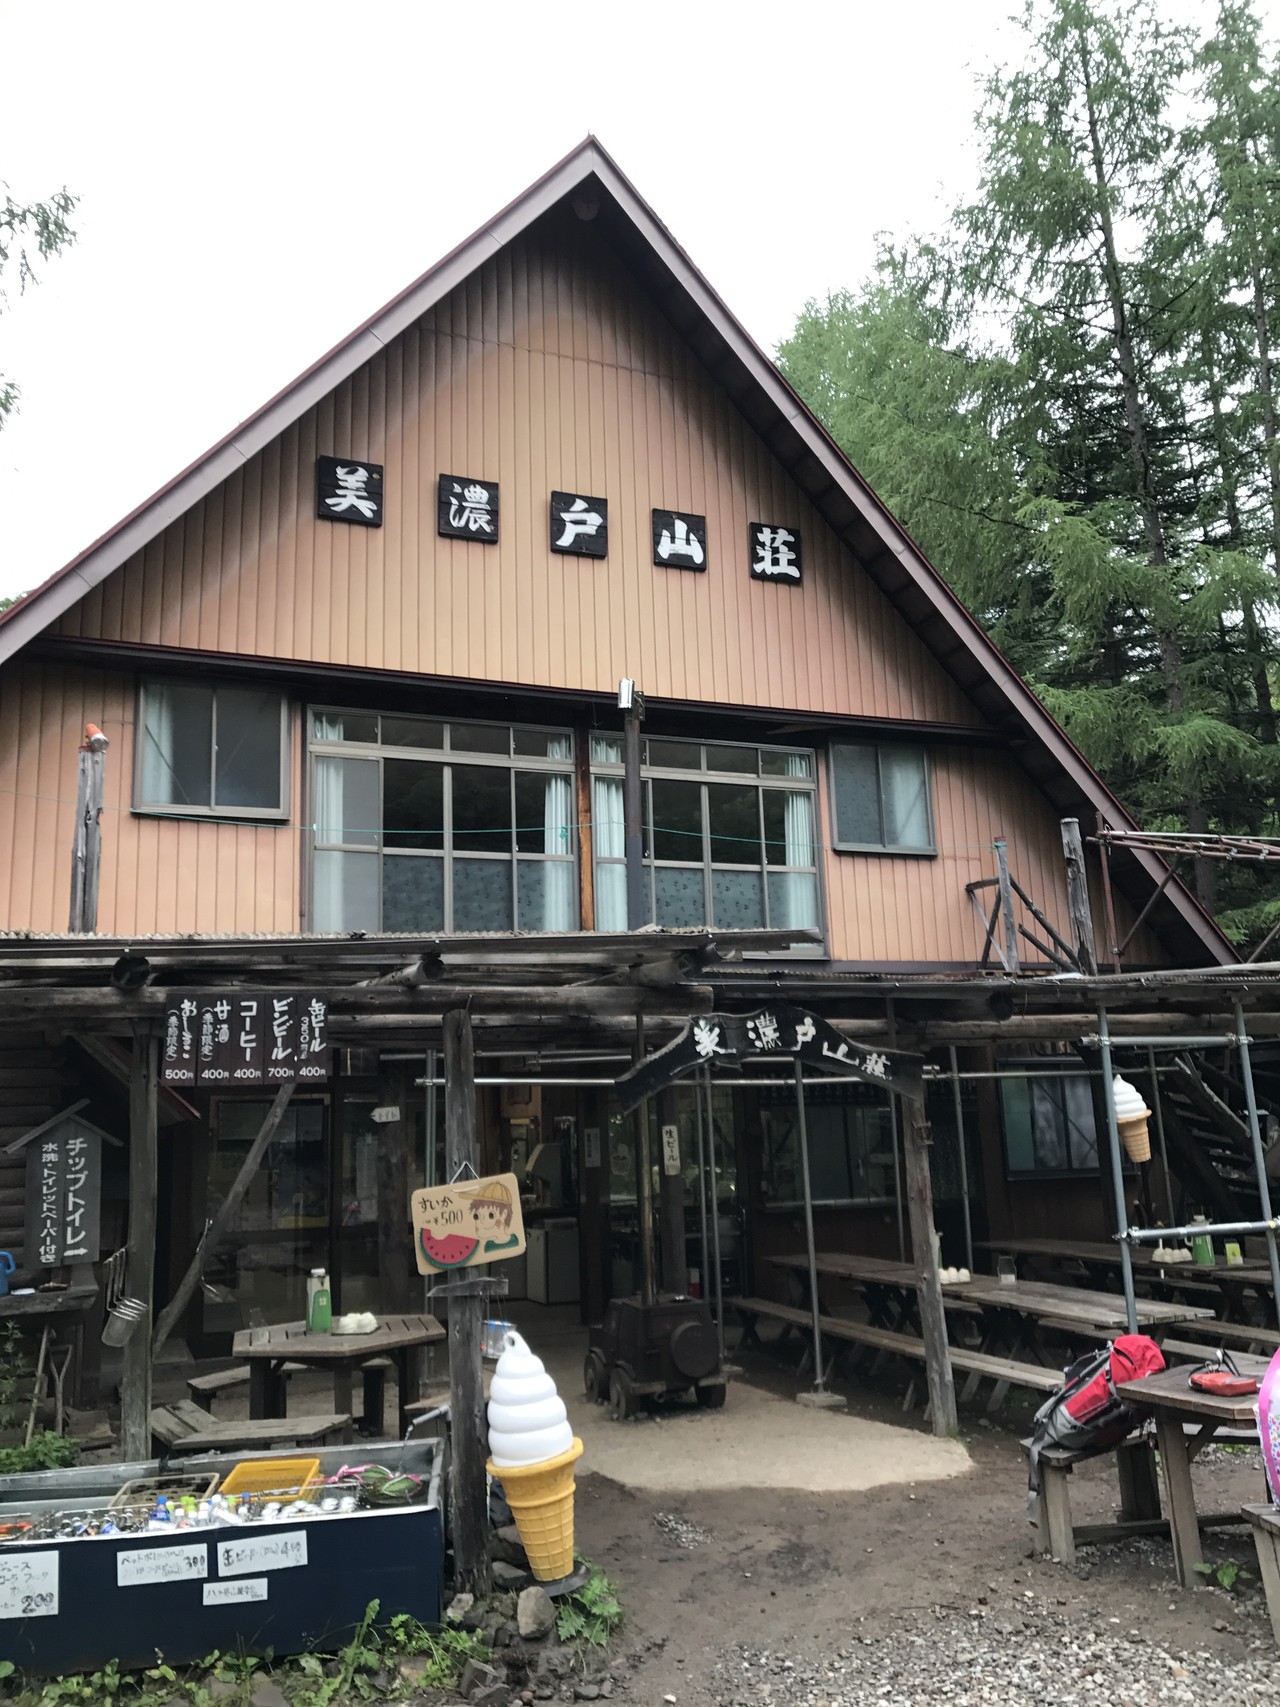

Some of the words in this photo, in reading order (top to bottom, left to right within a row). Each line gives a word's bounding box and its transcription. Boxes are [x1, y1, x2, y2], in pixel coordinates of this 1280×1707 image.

[324, 465, 801, 578] 美濃戸山荘
[213, 999, 231, 1044] 甘酒
[239, 1001, 257, 1062] コーヒー
[271, 997, 294, 1060] ビンビール
[307, 997, 327, 1052] 缶ビール
[693, 1010, 893, 1081] 美濃戸山荘
[165, 1069, 194, 1080] 500円
[201, 1069, 230, 1079] 400円
[233, 1068, 262, 1079] 400円
[268, 1067, 295, 1078] 700円
[299, 1066, 327, 1077] 400円
[665, 1128, 679, 1162] 生ビール
[65, 1138, 89, 1245] チップトイレ
[418, 1195, 454, 1214] すいか
[21, 1592, 54, 1614] 200
